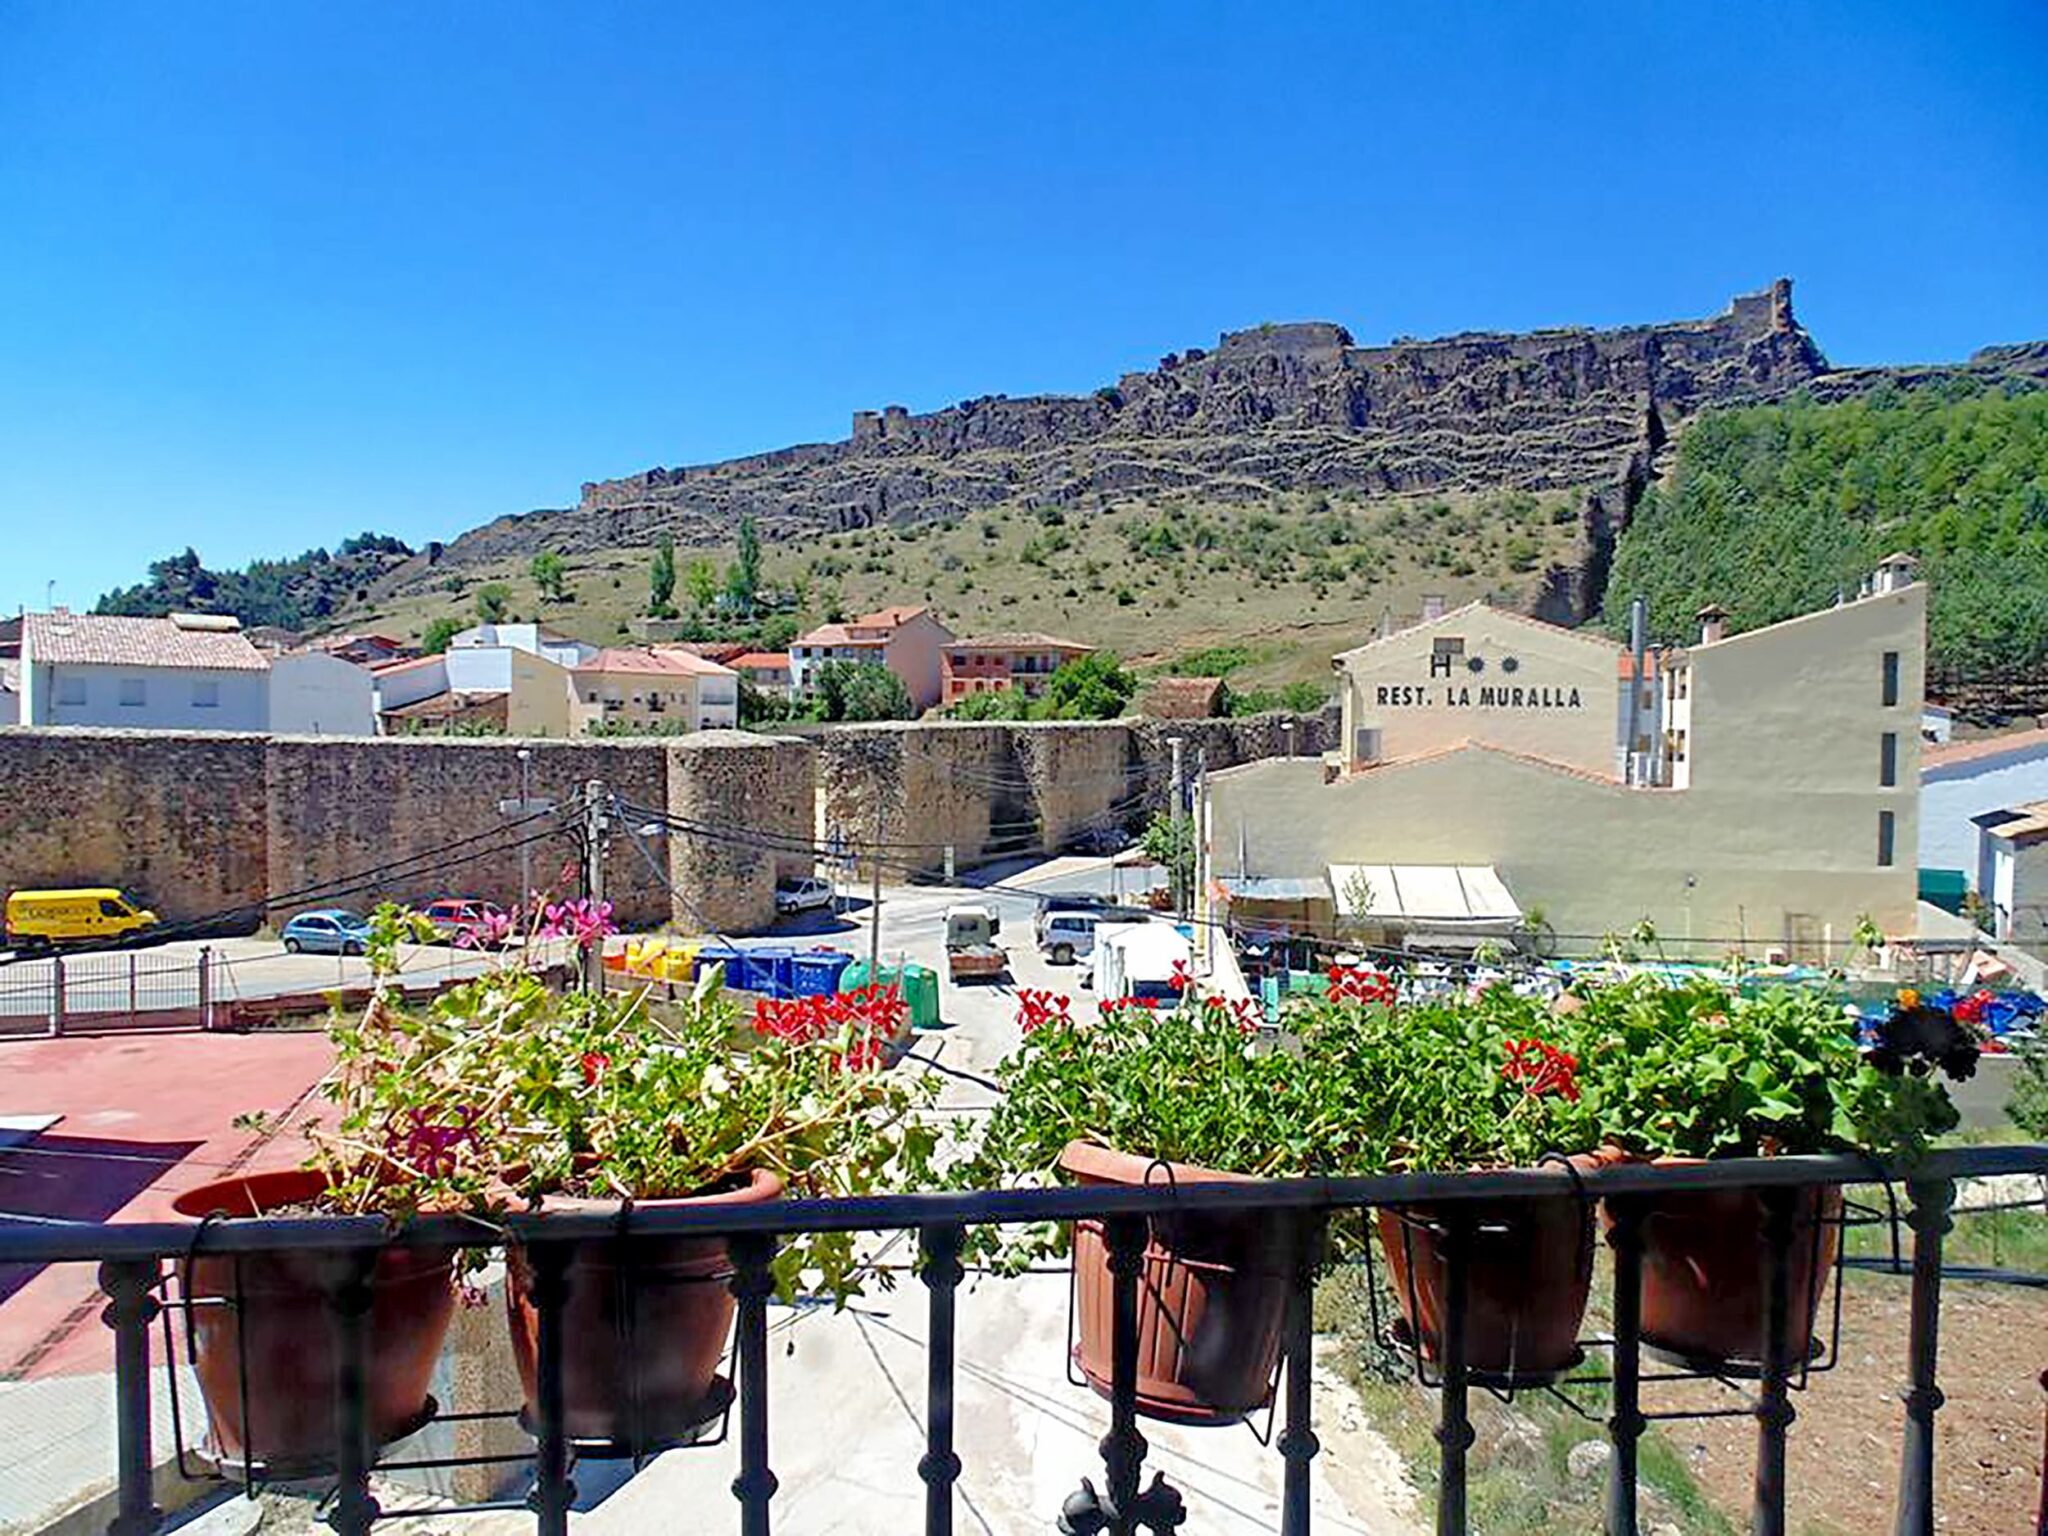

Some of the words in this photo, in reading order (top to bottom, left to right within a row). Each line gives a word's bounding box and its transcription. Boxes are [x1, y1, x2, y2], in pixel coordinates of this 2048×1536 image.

[1431, 654, 1451, 678] H
[1377, 686, 1432, 706] REST.
[1447, 687, 1470, 706] LA
[1480, 686, 1581, 708] MURALLA
